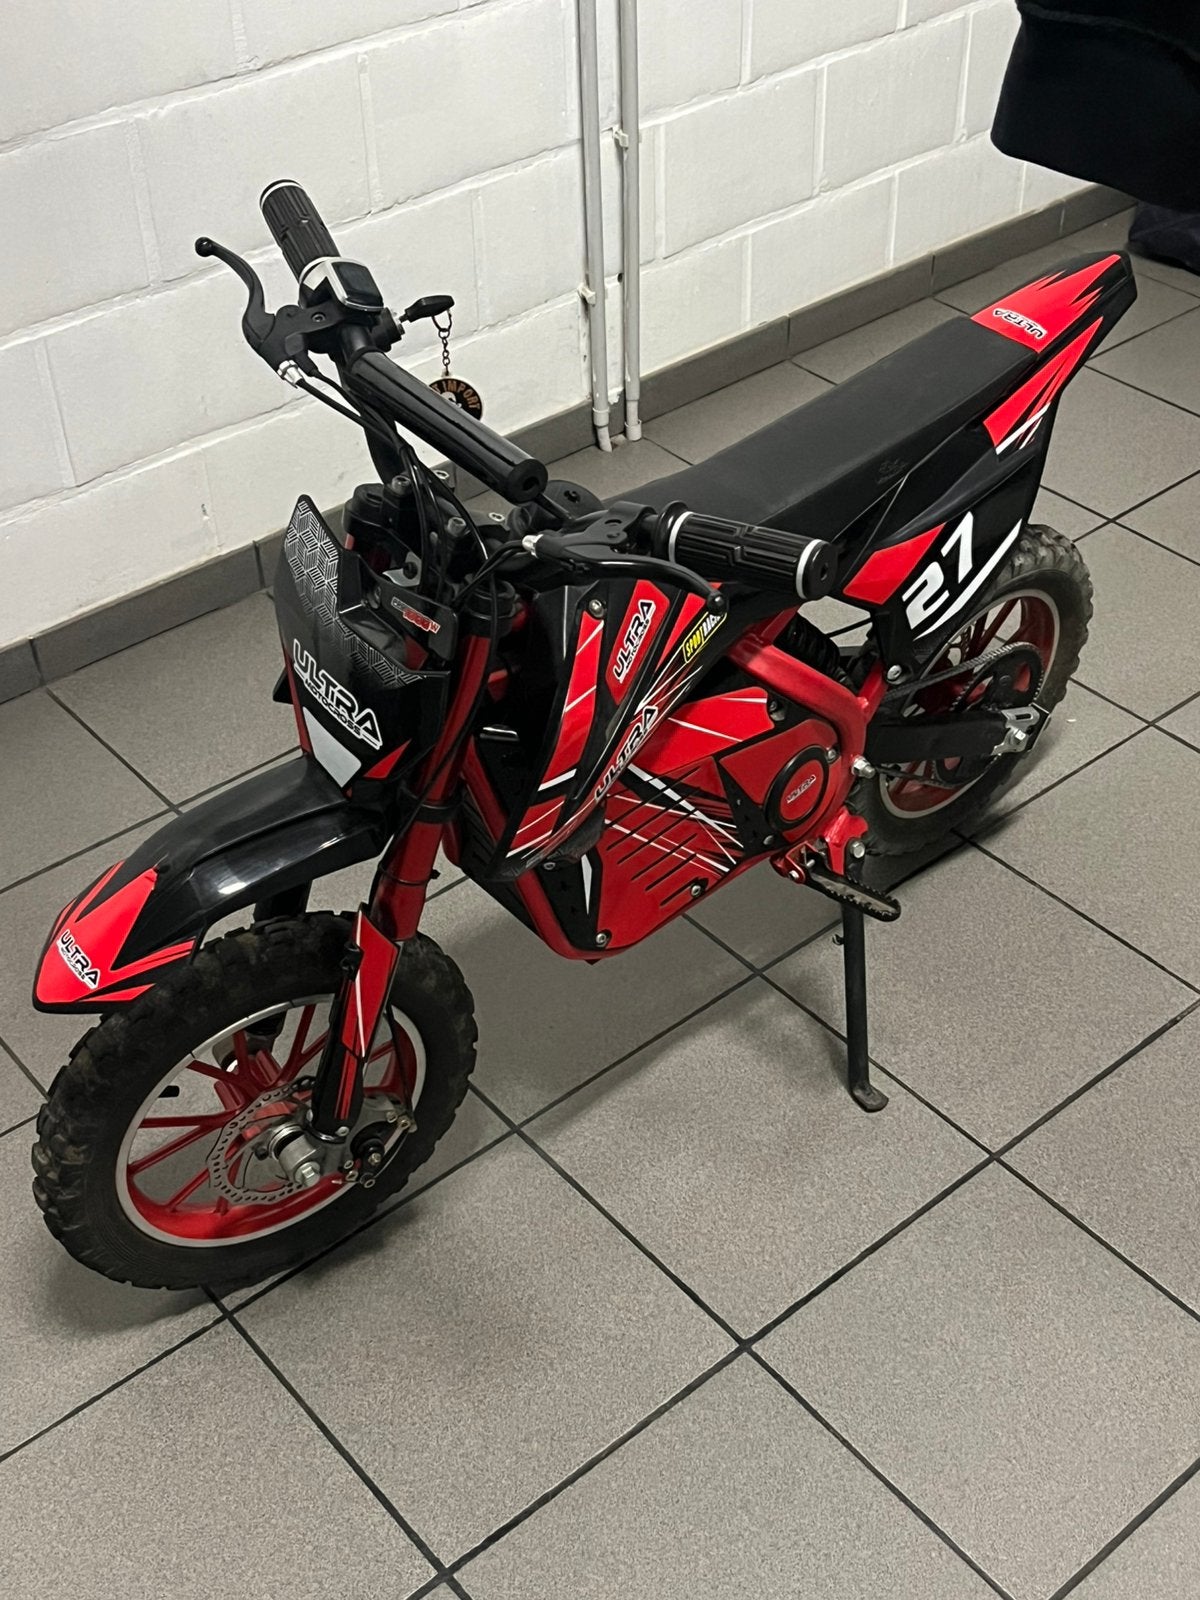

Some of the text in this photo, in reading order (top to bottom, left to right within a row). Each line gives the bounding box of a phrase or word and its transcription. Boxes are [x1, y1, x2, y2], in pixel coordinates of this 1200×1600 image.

[994, 309, 1045, 339] ULTRA
[442, 380, 481, 409] IMPORT
[902, 511, 974, 630] 27
[613, 600, 655, 679] ULTRA
[294, 639, 382, 746] ULTRA
[303, 678, 361, 737] MOTOCROSS
[595, 706, 658, 799] ULTRA
[60, 930, 99, 986] ULTRA
